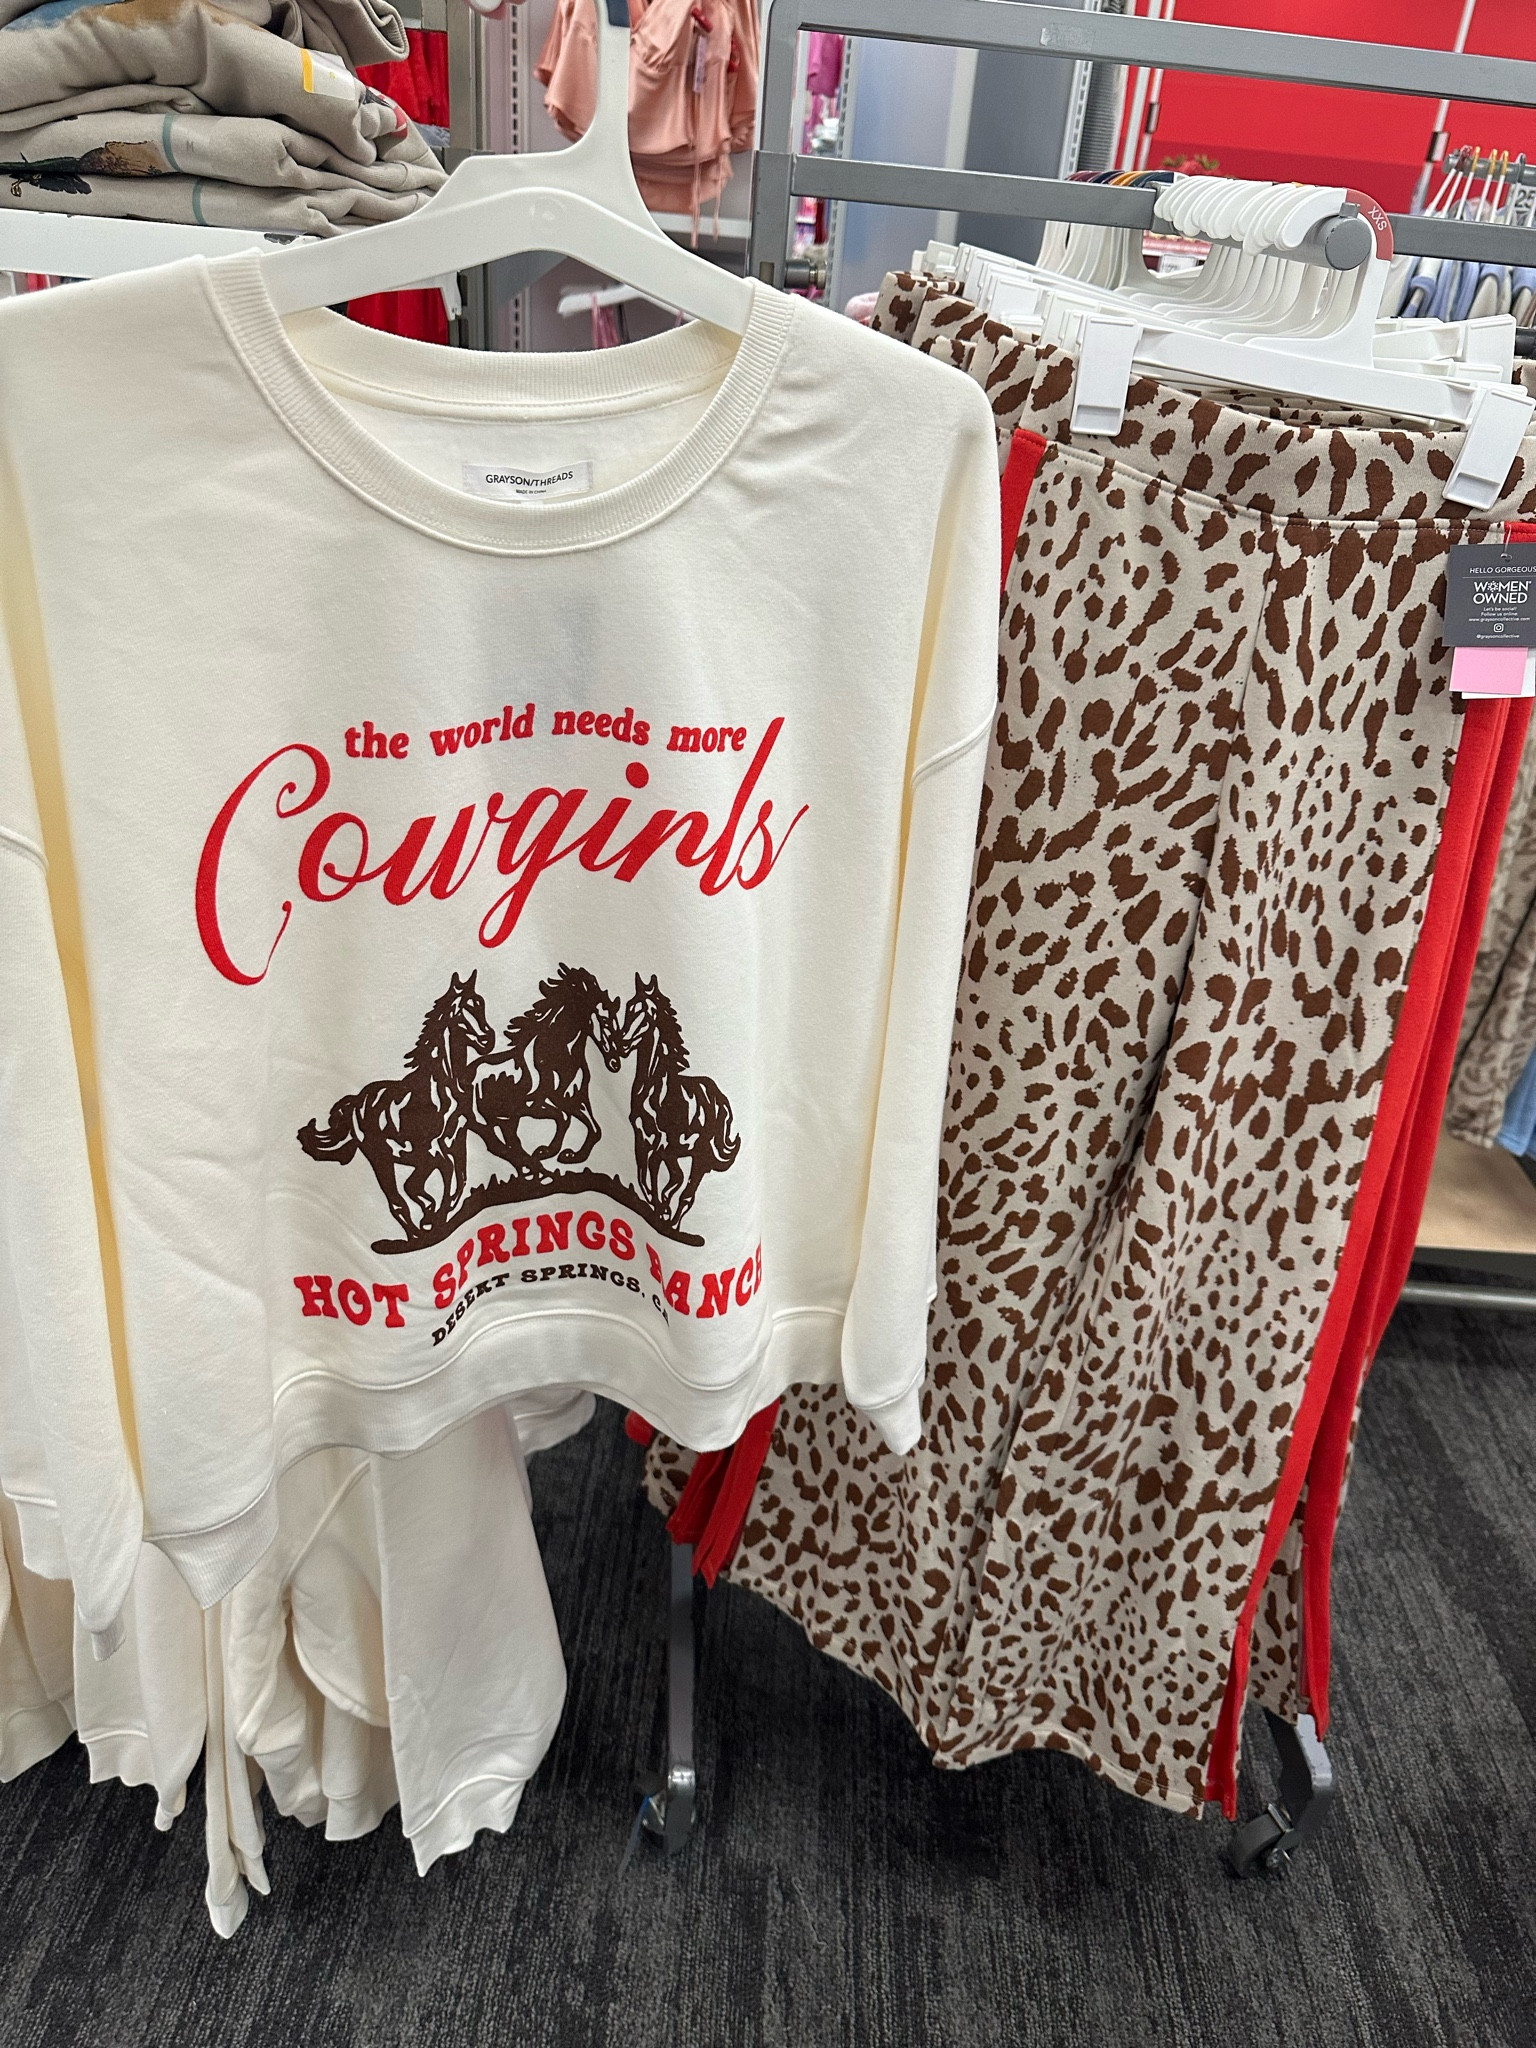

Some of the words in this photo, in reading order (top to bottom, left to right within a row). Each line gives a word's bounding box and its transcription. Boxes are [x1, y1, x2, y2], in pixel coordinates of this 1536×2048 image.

[186, 140, 194, 152] M
[1367, 205, 1387, 231] XXS
[485, 470, 574, 487] GRAYSON/THREADS
[1473, 592, 1528, 605] OWNED
[344, 720, 410, 760] the
[429, 702, 536, 757] world
[551, 706, 652, 747] needs
[666, 721, 748, 754] more
[195, 716, 810, 986] Cowgirls
[293, 1274, 411, 1329] HOT
[432, 1210, 637, 1310] SPRINGS
[431, 1272, 510, 1347] DESERT
[520, 1262, 646, 1298] SPRINGS,
